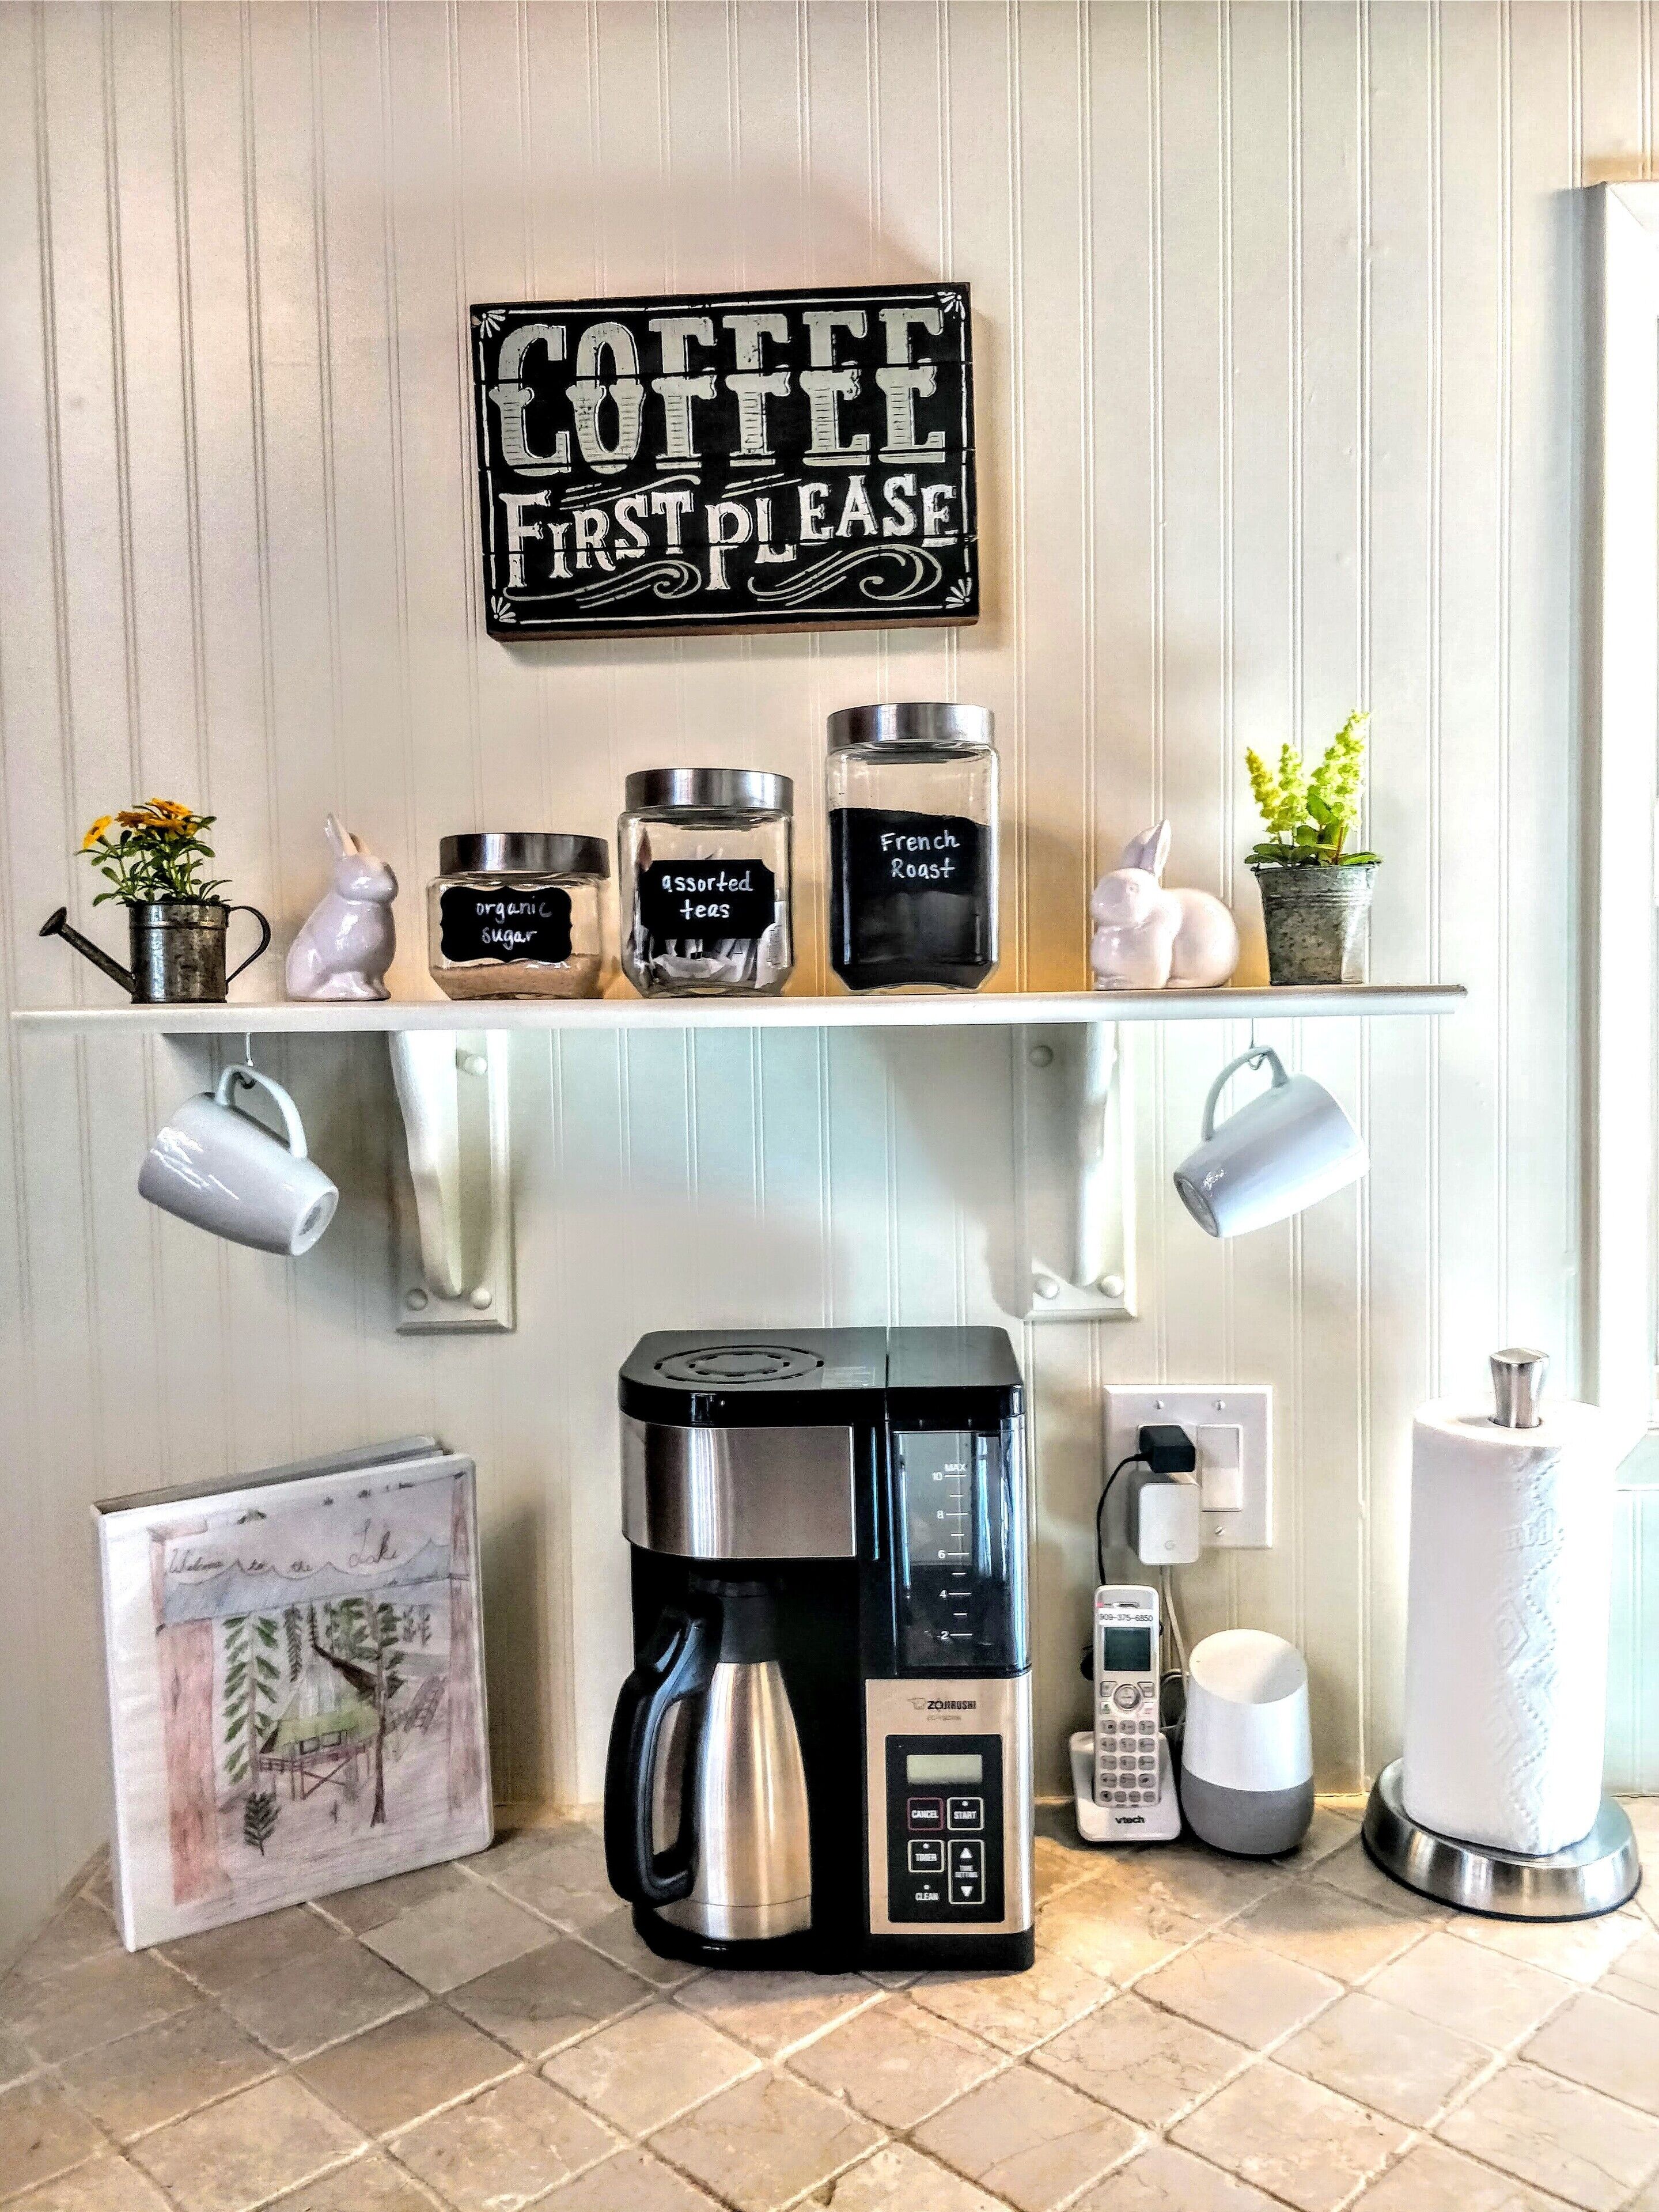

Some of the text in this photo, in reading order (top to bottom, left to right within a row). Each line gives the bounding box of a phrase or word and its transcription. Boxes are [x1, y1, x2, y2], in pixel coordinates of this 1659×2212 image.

[489, 308, 948, 476] COFFEE
[498, 473, 959, 590] FIRST PLEASE
[880, 830, 961, 851] French
[891, 857, 955, 879] Roast
[661, 871, 754, 894] assorted
[476, 895, 553, 916] organic
[680, 900, 730, 920] teas
[482, 927, 537, 950] sugar
[932, 1473, 943, 1481] 10
[937, 1510, 945, 1520] 8
[938, 1550, 946, 1559] 6
[939, 1590, 947, 1599] 4
[941, 1631, 949, 1639] 2
[927, 1699, 977, 1710] ZOJIRUSHI
[911, 1810, 940, 1819] CANCEL
[953, 1810, 978, 1820] START
[1115, 1816, 1146, 1824] vtech
[915, 1853, 937, 1862] TIMER
[915, 1892, 940, 1901] CLEAN
